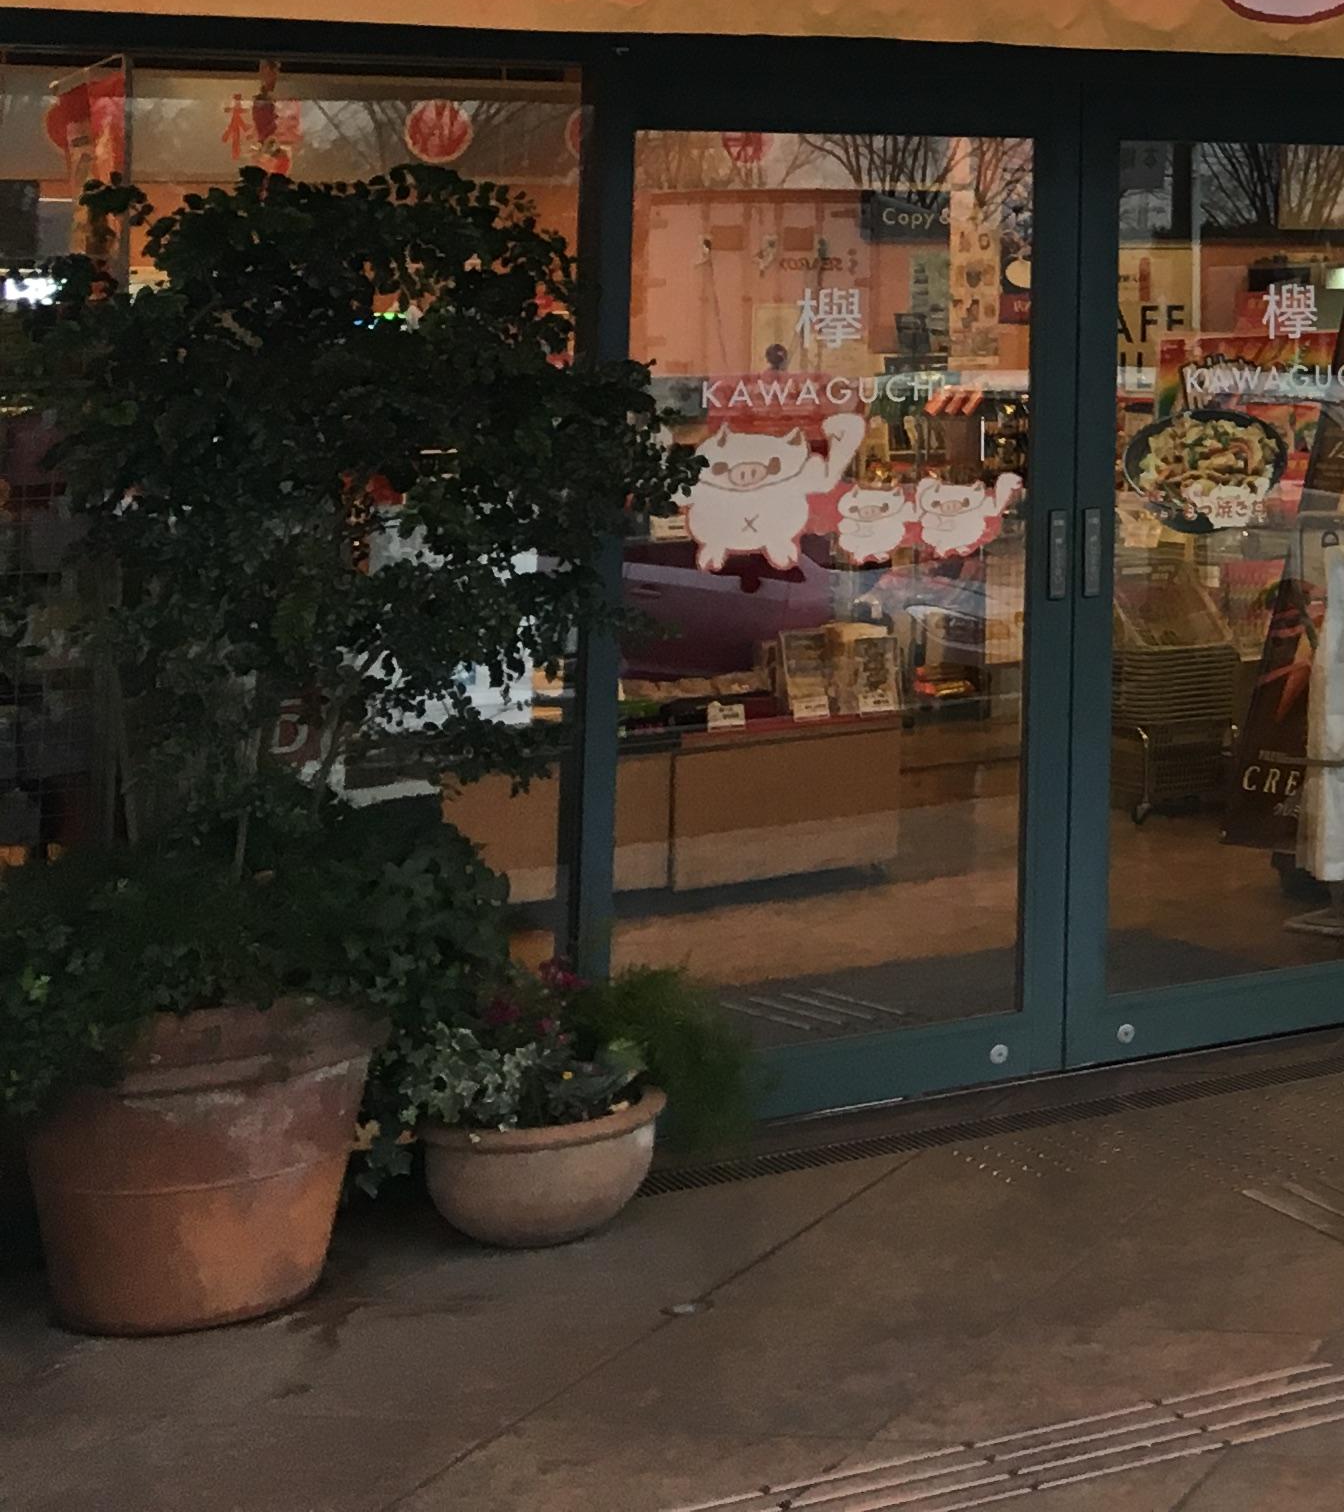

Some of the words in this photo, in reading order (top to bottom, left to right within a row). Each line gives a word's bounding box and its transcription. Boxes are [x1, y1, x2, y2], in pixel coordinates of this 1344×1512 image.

[882, 207, 935, 230] Copy
[796, 286, 863, 351] 欅
[1262, 282, 1318, 341] 欅
[701, 374, 949, 409] KAWAGUCHI
[1241, 764, 1302, 798] CRE
